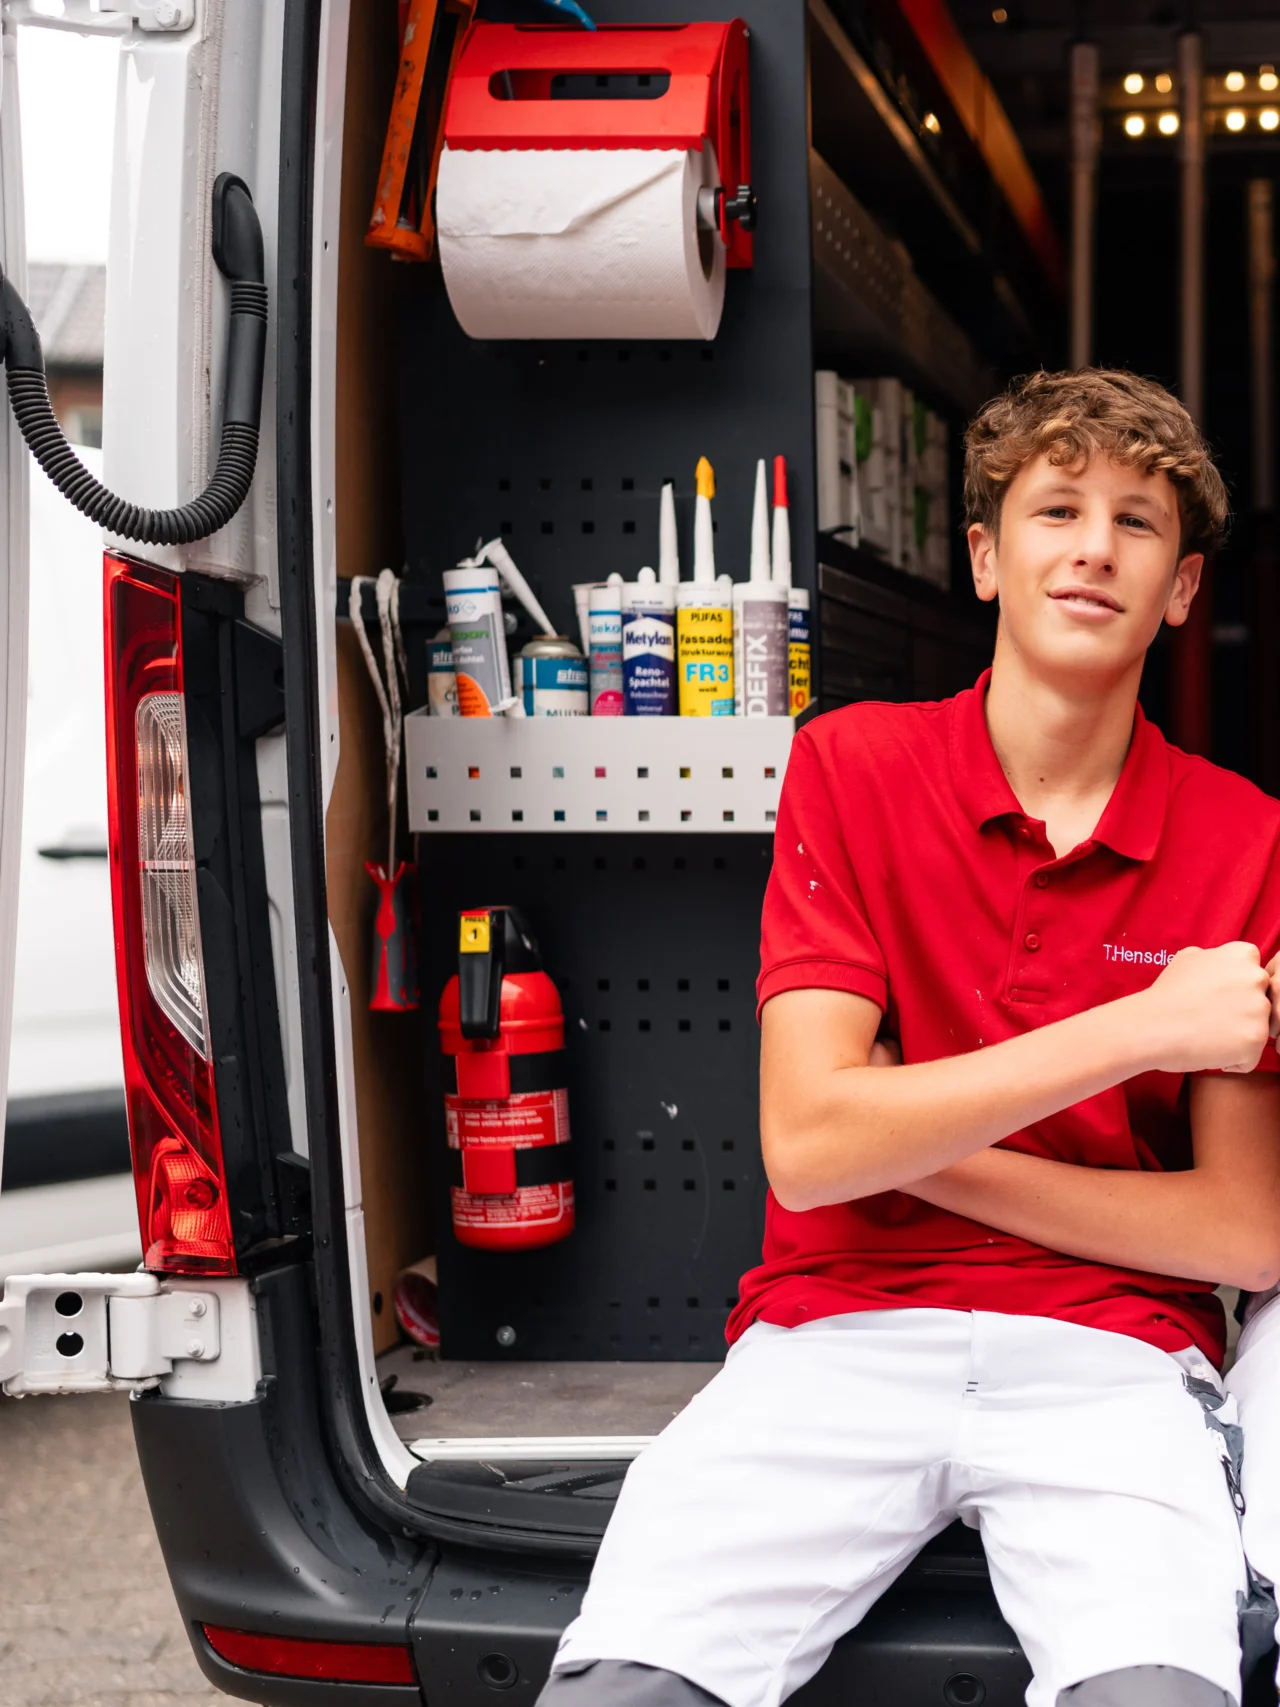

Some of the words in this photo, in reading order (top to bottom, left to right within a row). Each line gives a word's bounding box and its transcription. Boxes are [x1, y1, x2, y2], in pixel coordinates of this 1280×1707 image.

[625, 631, 672, 647] Metylan
[635, 666, 665, 678] Reno-
[629, 676, 670, 690] Spachtel
[472, 928, 477, 940] 1
